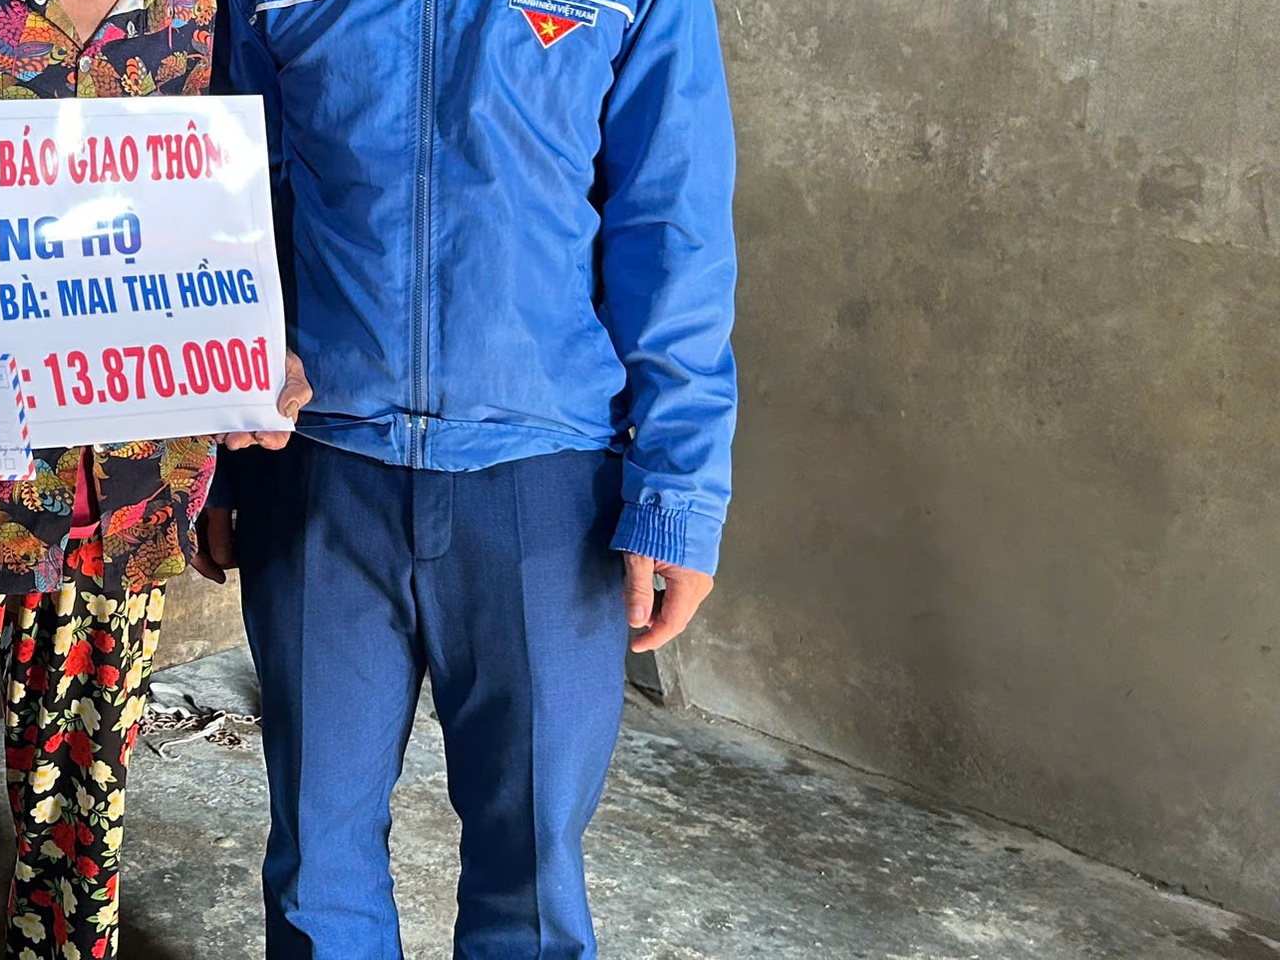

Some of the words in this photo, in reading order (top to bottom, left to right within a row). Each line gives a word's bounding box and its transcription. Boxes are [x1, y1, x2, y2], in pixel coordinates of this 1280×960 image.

[575, 8, 595, 21] NAM
[68, 135, 139, 184] GIAO
[147, 119, 232, 181] THÔN
[57, 277, 118, 317] MAI
[122, 272, 174, 318] THỊ
[176, 258, 260, 308] HỒNG
[43, 336, 271, 407] 13.870.000đ
